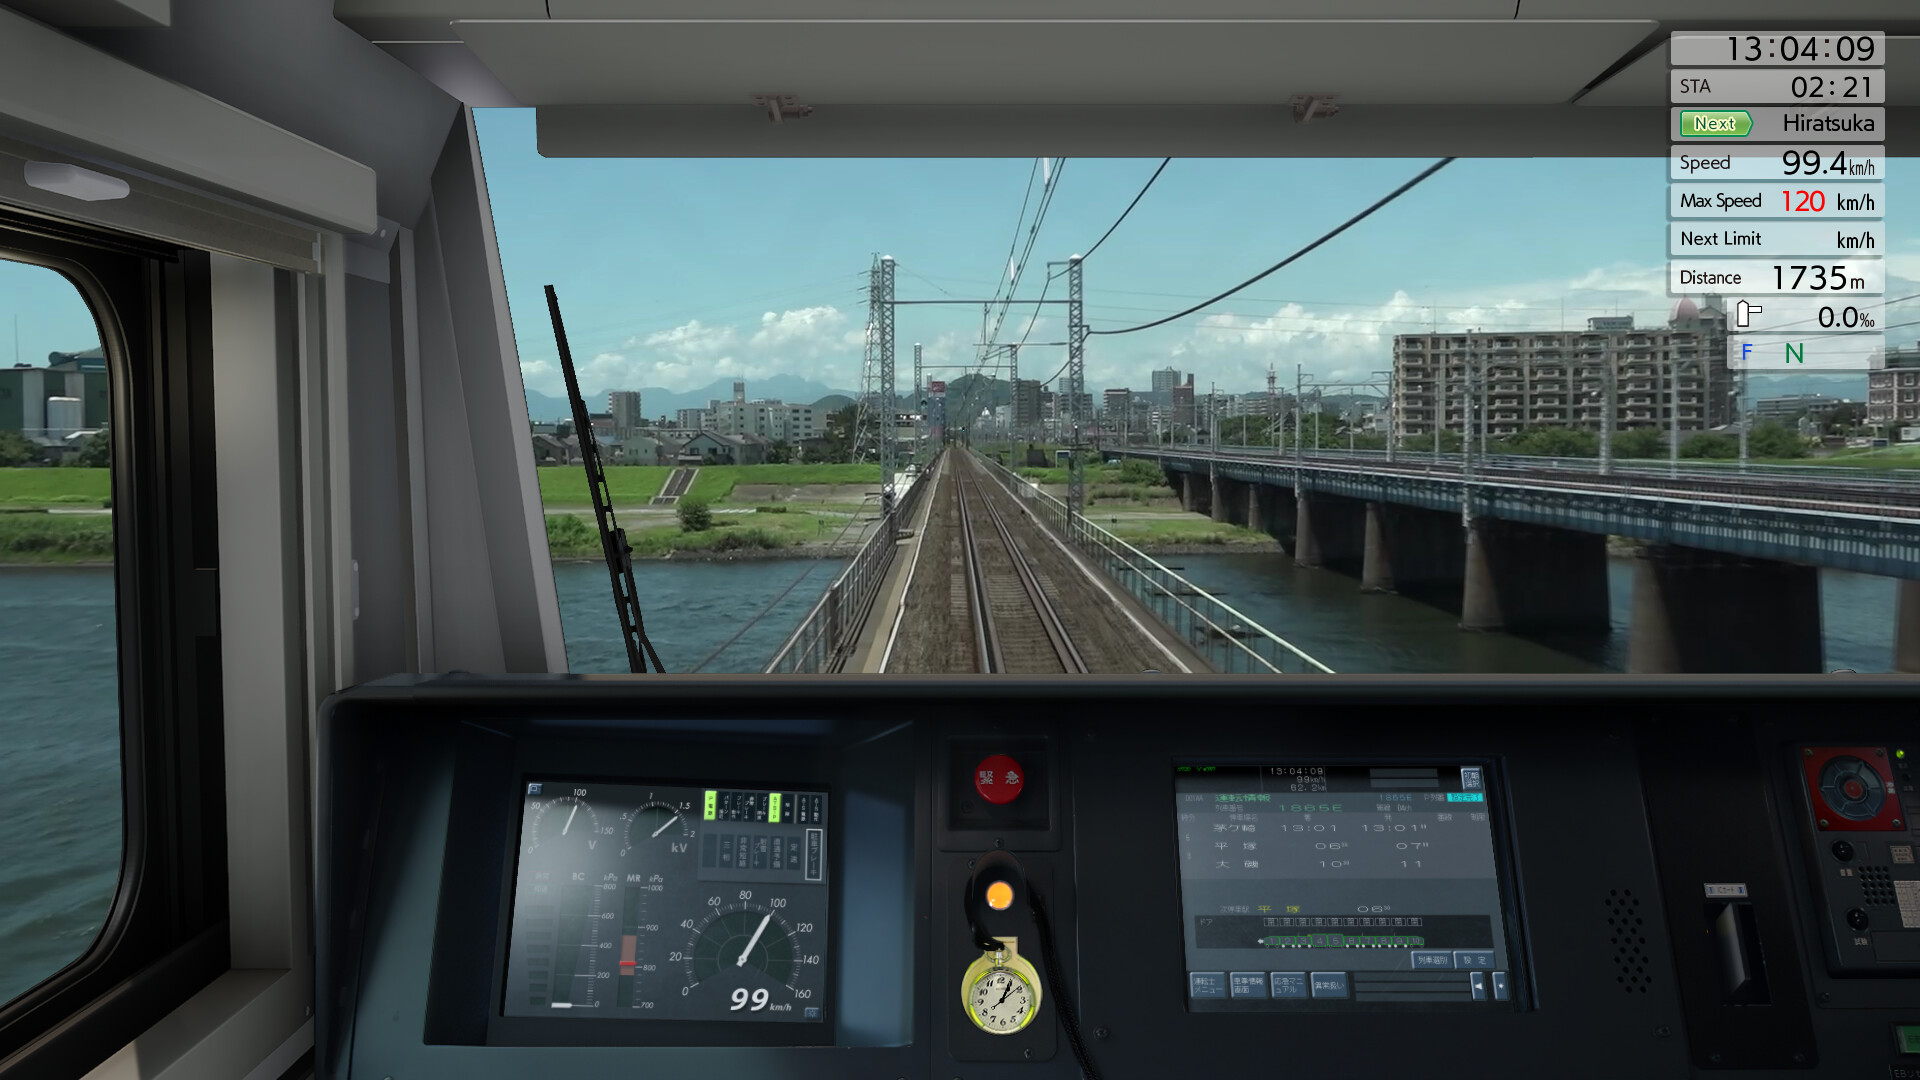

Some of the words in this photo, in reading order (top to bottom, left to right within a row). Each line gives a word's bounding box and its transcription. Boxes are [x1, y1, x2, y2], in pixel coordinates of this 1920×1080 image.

[1271, 767, 1324, 775] 13:04:09
[573, 788, 587, 797] 100
[531, 802, 541, 810] 50
[679, 802, 691, 810] 1.5
[1279, 804, 1343, 813] 1865E
[600, 827, 614, 835] 150
[1281, 824, 1337, 832] 13:01
[588, 840, 597, 850] V
[672, 842, 688, 853] kV
[620, 849, 626, 857] 0
[572, 872, 585, 881] BC
[603, 872, 618, 882] kPa
[626, 874, 641, 882] MR
[649, 874, 664, 883] kPa
[739, 890, 752, 900] 80
[708, 896, 721, 906] 60
[770, 898, 787, 908] 100
[680, 919, 694, 929] 40
[796, 923, 813, 933] 120
[669, 952, 682, 962] 20
[803, 955, 820, 965] 140
[597, 971, 610, 979] 200
[997, 976, 1005, 984] 12
[682, 986, 689, 996] 0
[794, 989, 812, 999] 160
[979, 988, 988, 996] 10
[1195, 986, 1223, 994] メニュー
[730, 988, 769, 1012] 99
[770, 1003, 792, 1013] km/h
[977, 998, 984, 1006] 9
[1020, 996, 1026, 1004] 3
[641, 1001, 654, 1009] 700
[982, 1008, 988, 1016] 8
[1017, 1006, 1024, 1014] 4
[990, 1015, 997, 1023] 7
[1000, 1018, 1006, 1026] 6
[1010, 1015, 1016, 1023] 5
